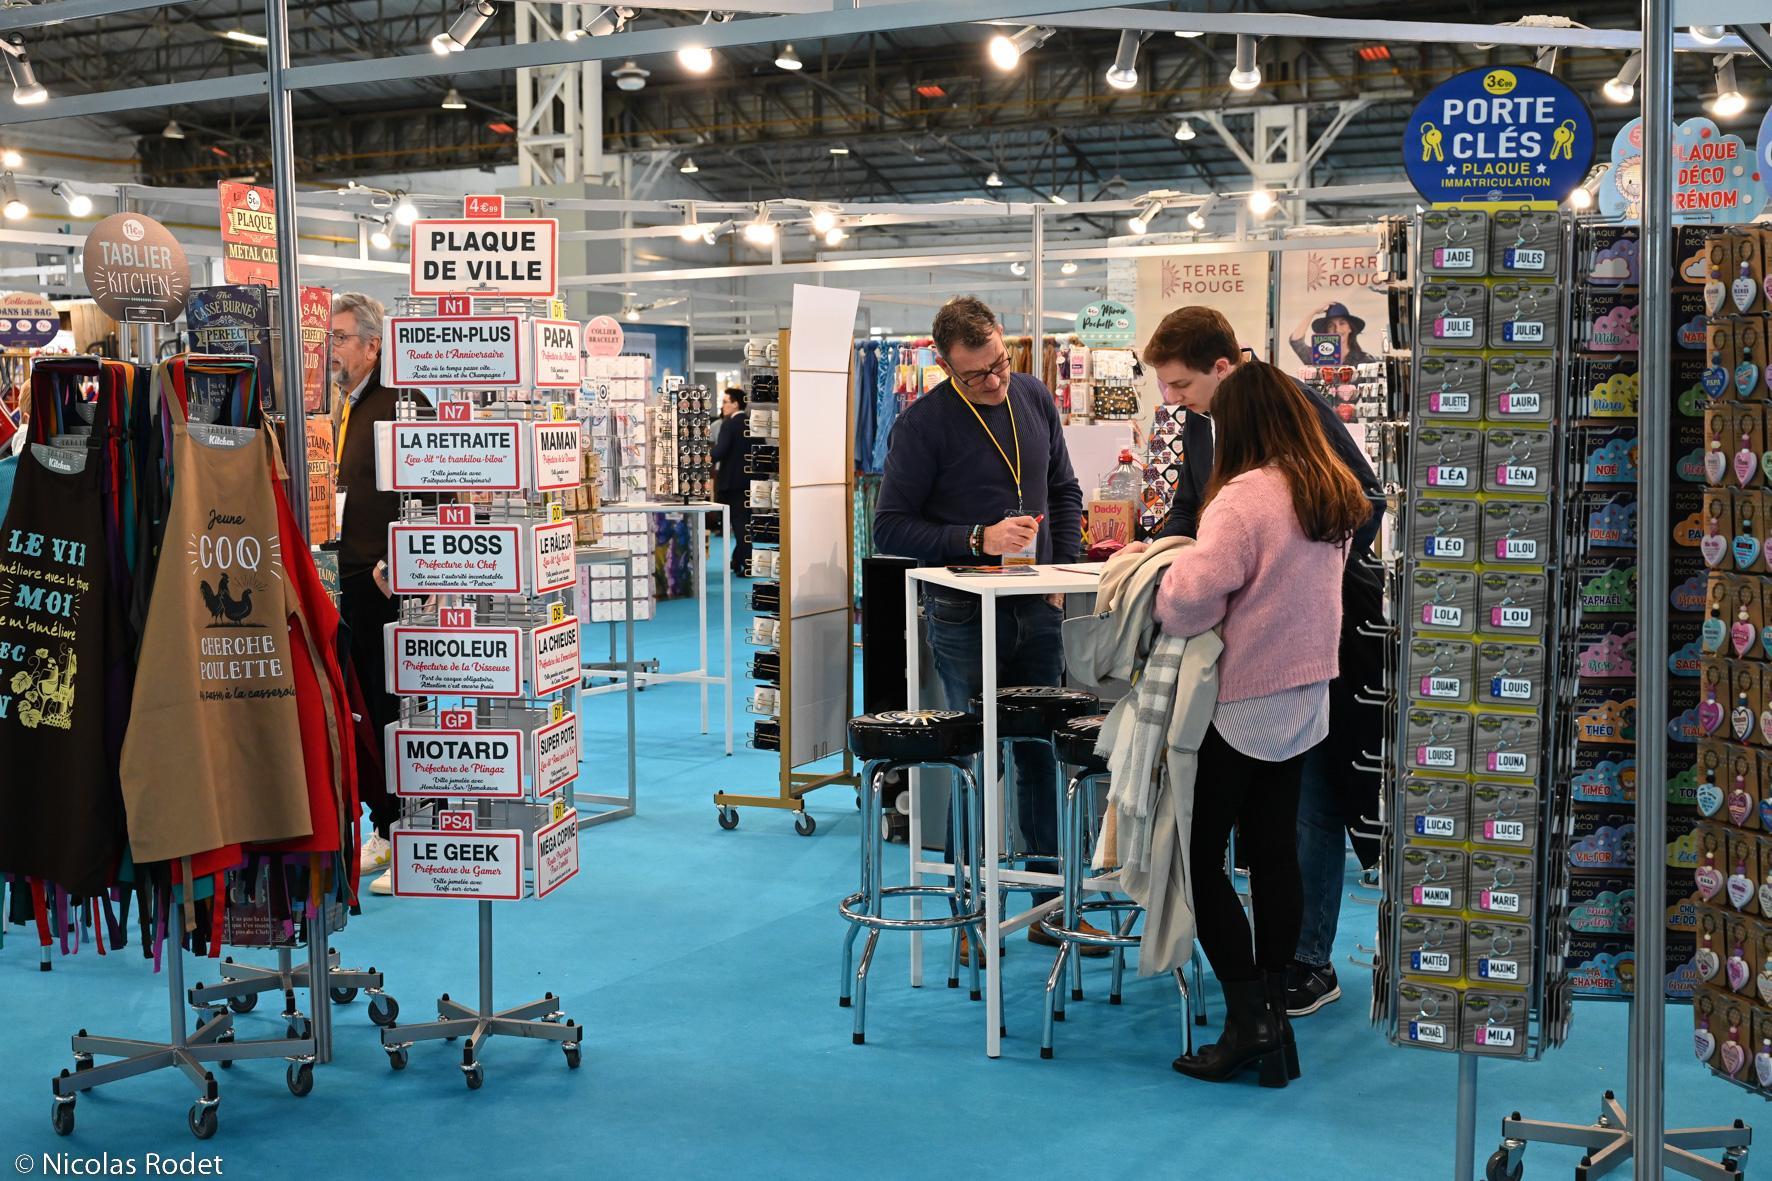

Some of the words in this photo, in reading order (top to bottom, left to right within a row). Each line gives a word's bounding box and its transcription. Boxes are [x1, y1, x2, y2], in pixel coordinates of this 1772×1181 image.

[1443, 97, 1555, 125] PORTE
[1453, 127, 1541, 158] CLÉS
[1462, 163, 1530, 175] PLAQUE
[1441, 177, 1550, 187] IMMATRICULATION
[1679, 165, 1725, 187] DÉCO
[469, 199, 498, 213] 4€99
[238, 212, 273, 231] PLAQUE
[431, 232, 536, 253] PLAQUE
[99, 242, 172, 269] TABLIER
[229, 242, 260, 260] MÉTAL
[1445, 251, 1471, 262] JADE
[1515, 251, 1542, 264] JULES
[424, 261, 456, 281] DE
[467, 261, 542, 281] VILLE
[1183, 264, 1240, 277] TERRE
[108, 271, 170, 296] KITCHEN
[1182, 280, 1244, 293] ROUGE
[216, 291, 232, 299] The
[194, 301, 221, 320] CASSE
[223, 301, 258, 319] BURNES
[311, 300, 328, 322] ANS
[445, 300, 463, 314] N1
[1101, 304, 1126, 316] Miroir
[1446, 320, 1471, 332] JULIE
[1515, 324, 1541, 335] JULIEN
[207, 328, 248, 340] PERFECT
[399, 326, 511, 343] RIDE-EN-PLUS
[544, 327, 573, 348] PAPA
[407, 350, 432, 359] Route
[435, 350, 444, 359] de
[1441, 395, 1467, 406] JULIETTE
[1511, 394, 1537, 407] LAURA
[445, 405, 464, 419] N7
[209, 435, 235, 446] Kitchen
[401, 433, 422, 448] LA
[427, 433, 510, 448] RETRAITE
[541, 431, 577, 450] MAMAN
[49, 458, 71, 471] Kitchen
[404, 454, 434, 466] Lieu-dit
[447, 470, 467, 479] jumelée
[1440, 468, 1464, 480] LÉA
[1508, 468, 1534, 481] LÉNA
[1596, 464, 1618, 475] NOÉ
[447, 510, 464, 522] N1
[1094, 505, 1122, 514] Daddy
[207, 509, 245, 530] Jeune
[8, 529, 44, 557] LE
[409, 535, 435, 554] LE
[443, 535, 502, 554] BOSS
[540, 538, 548, 554] LE
[550, 532, 572, 552] RÂLEUR
[1437, 538, 1461, 550] LÉO
[1508, 542, 1534, 553] LILOU
[200, 535, 261, 572] COQ
[416, 559, 462, 569] Préfecture
[464, 560, 474, 568] du
[477, 560, 497, 569] Chef
[45, 572, 65, 585] avec
[67, 574, 74, 586] le
[14, 584, 73, 617] MOI
[1583, 593, 1622, 606] RAPHAËL
[447, 612, 465, 625] N1
[553, 608, 561, 621] D9
[1434, 608, 1459, 621] LOLA
[1503, 611, 1528, 621] LOU
[10, 615, 76, 641] m'améliore
[201, 635, 276, 656] CHERCHE
[539, 638, 547, 654] LA
[549, 629, 576, 652] CHIEUSE
[406, 640, 507, 657] BRICOLEUR
[200, 658, 284, 680] POULETTE
[403, 660, 448, 672] Préfecture
[450, 661, 459, 670] de
[472, 662, 511, 672] Visseuse
[1432, 679, 1458, 691] LOUANE
[1503, 681, 1529, 693] LOUIS
[225, 687, 232, 699] à
[234, 687, 245, 699] la
[554, 707, 561, 719] D1
[446, 714, 467, 727] GP
[1585, 724, 1614, 736] THÉO
[541, 733, 560, 756] SUPER
[561, 726, 575, 743] POTE
[407, 741, 508, 759] MOTARD
[1428, 748, 1453, 760] LOUISE
[1498, 754, 1525, 766] LOUNA
[412, 763, 458, 774] Préfecture
[460, 764, 469, 773] de
[471, 763, 504, 776] Plingaz
[449, 777, 469, 786] jumelée
[1582, 784, 1611, 795] TIMÉO
[555, 806, 561, 818] D1
[442, 816, 470, 828] PS4
[1426, 819, 1452, 831] LUCAS
[1496, 824, 1521, 835] LUCIE
[540, 834, 557, 857] MÉGA
[558, 823, 575, 849] COPINE
[414, 843, 437, 860] LE
[444, 844, 499, 862] GEEK
[1576, 852, 1612, 862] VICTOR
[412, 863, 458, 874] Préfecture
[460, 865, 470, 874] du
[473, 866, 501, 877] Gamer
[1572, 880, 1600, 888] PLAQUE
[1424, 889, 1449, 900] MANON
[1492, 895, 1516, 906] MARIE
[1422, 954, 1448, 966] MATTÉO
[1490, 963, 1516, 974] MAXIME
[1573, 978, 1615, 988] CHAMBRE
[1419, 1024, 1442, 1037] MICHAËL
[1488, 1029, 1512, 1041] MILA
